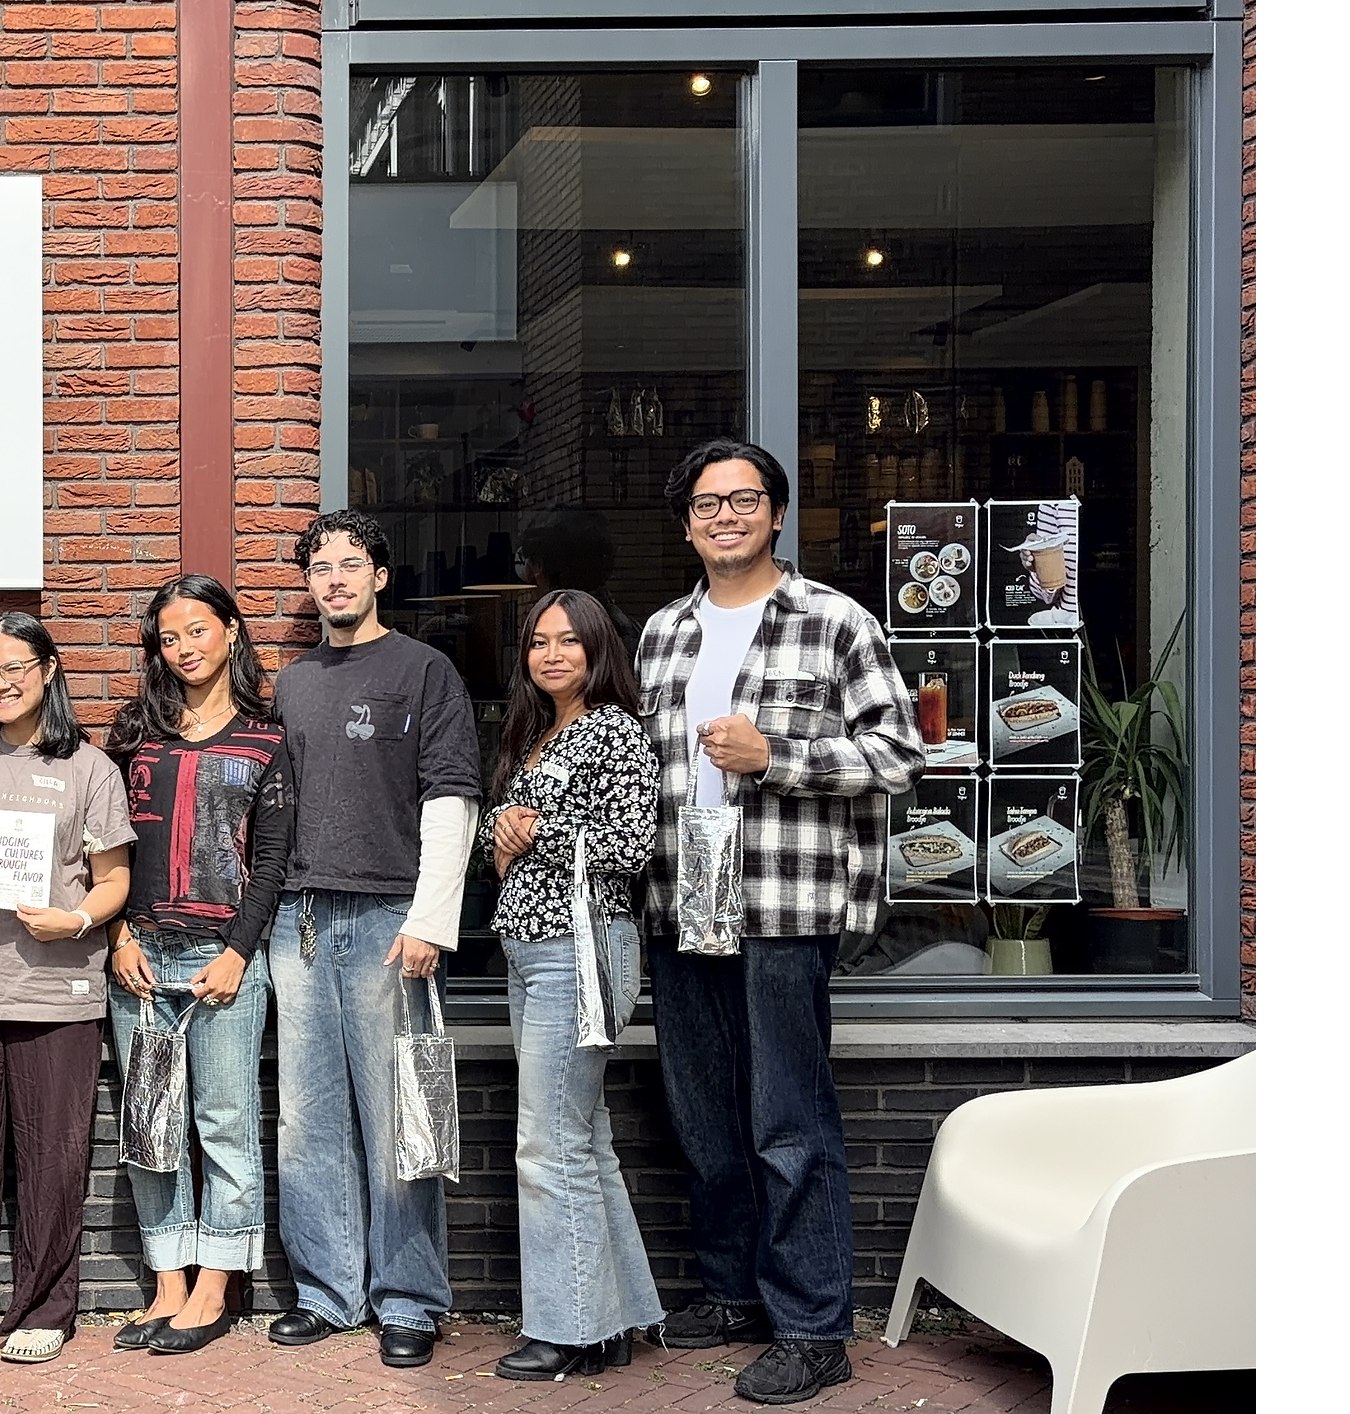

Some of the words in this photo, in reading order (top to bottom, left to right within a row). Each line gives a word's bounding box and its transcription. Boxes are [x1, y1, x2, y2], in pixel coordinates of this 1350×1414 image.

[896, 524, 917, 536] SOTO
[1, 792, 64, 809] NEIGHBORS
[4, 847, 44, 861] CULTURES
[12, 870, 44, 883] FLAVOR
